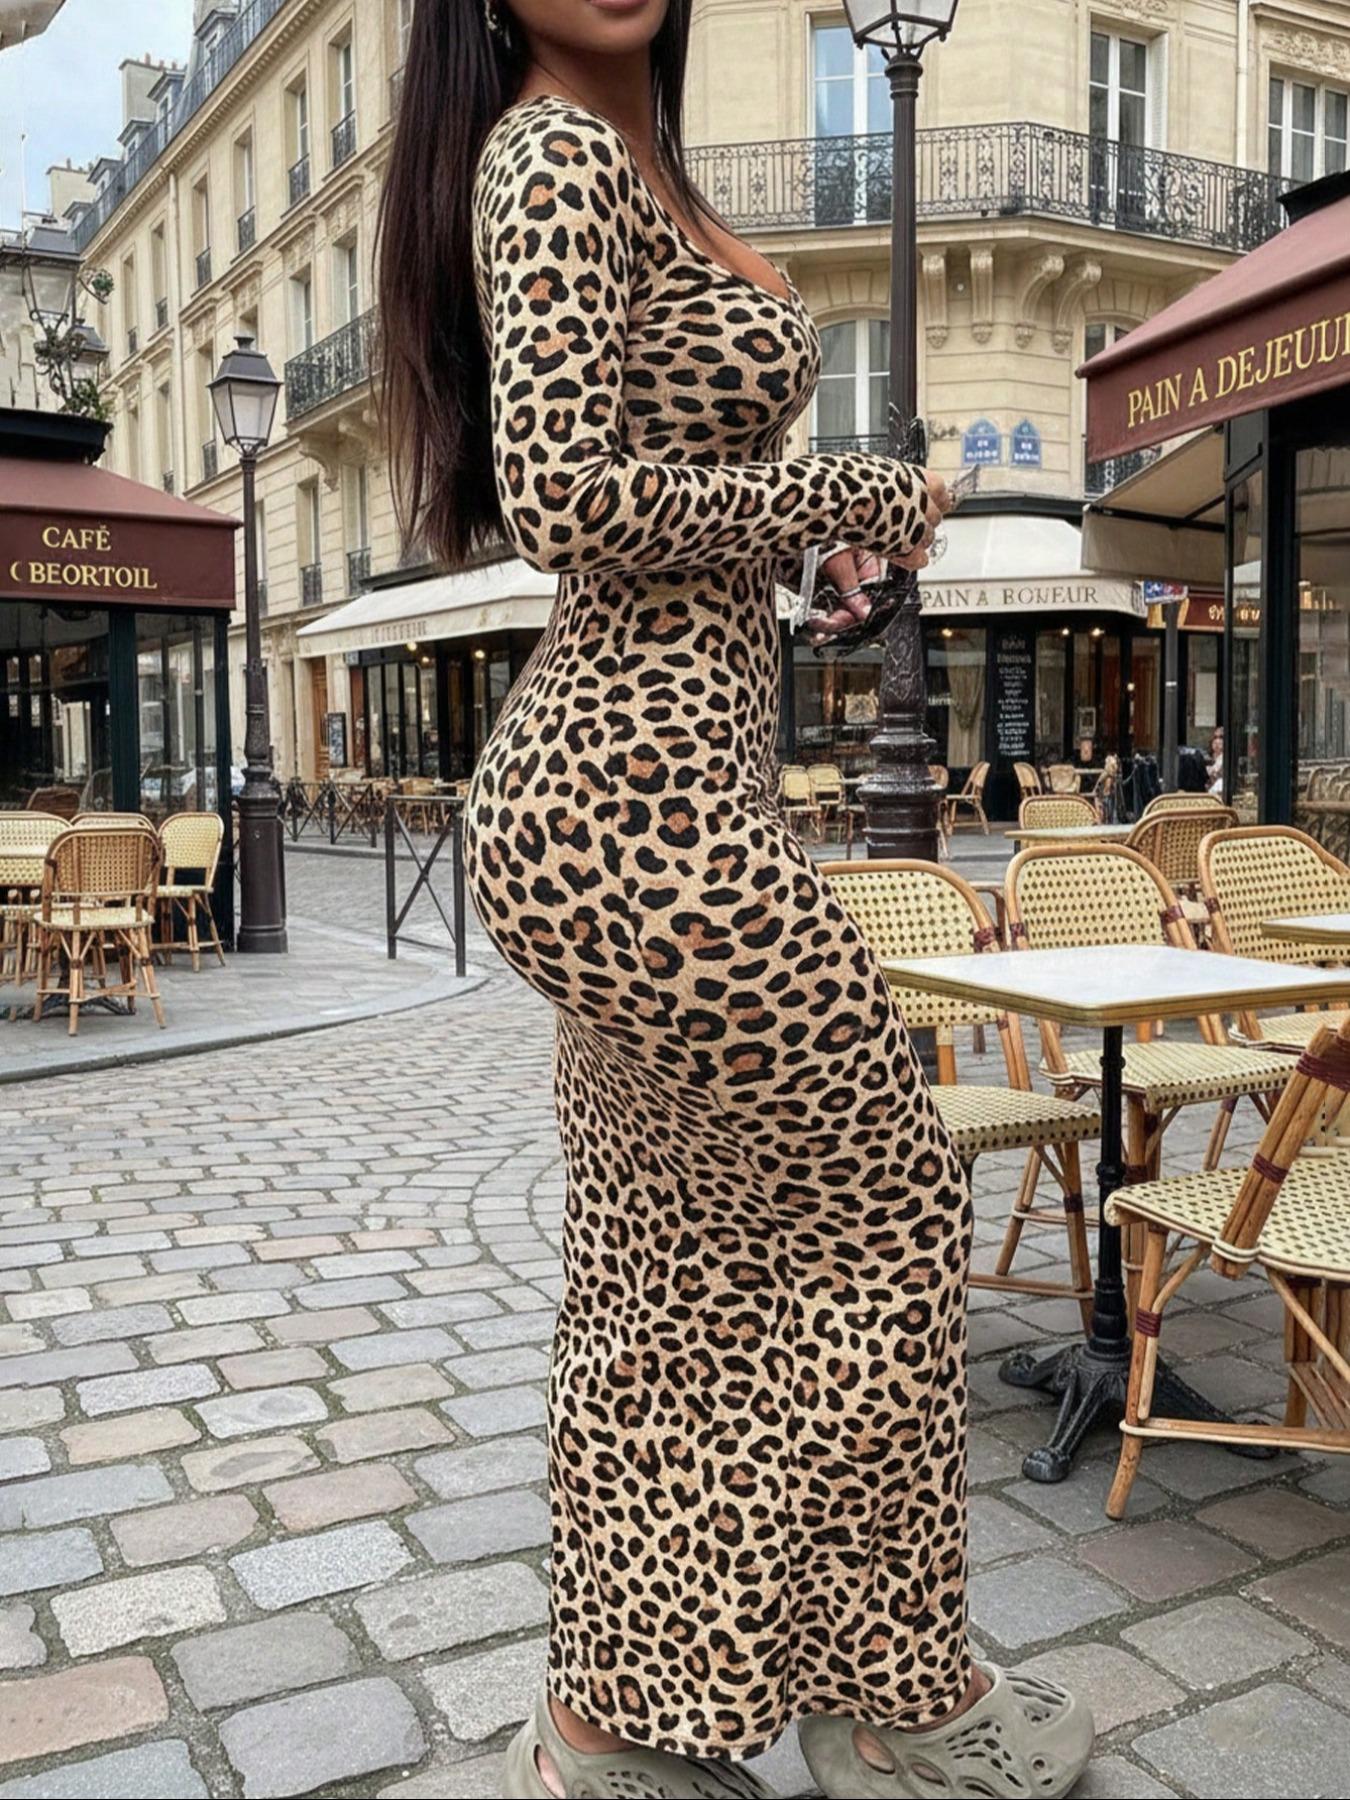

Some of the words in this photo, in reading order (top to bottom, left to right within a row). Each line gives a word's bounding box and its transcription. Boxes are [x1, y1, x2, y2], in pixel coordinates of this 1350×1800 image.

[1127, 373, 1183, 429] PAIN
[1188, 366, 1209, 408] A
[42, 525, 112, 552] CAFÉ
[28, 561, 158, 589] BEORTOIL
[922, 588, 972, 608] PAIN
[976, 589, 990, 607] A
